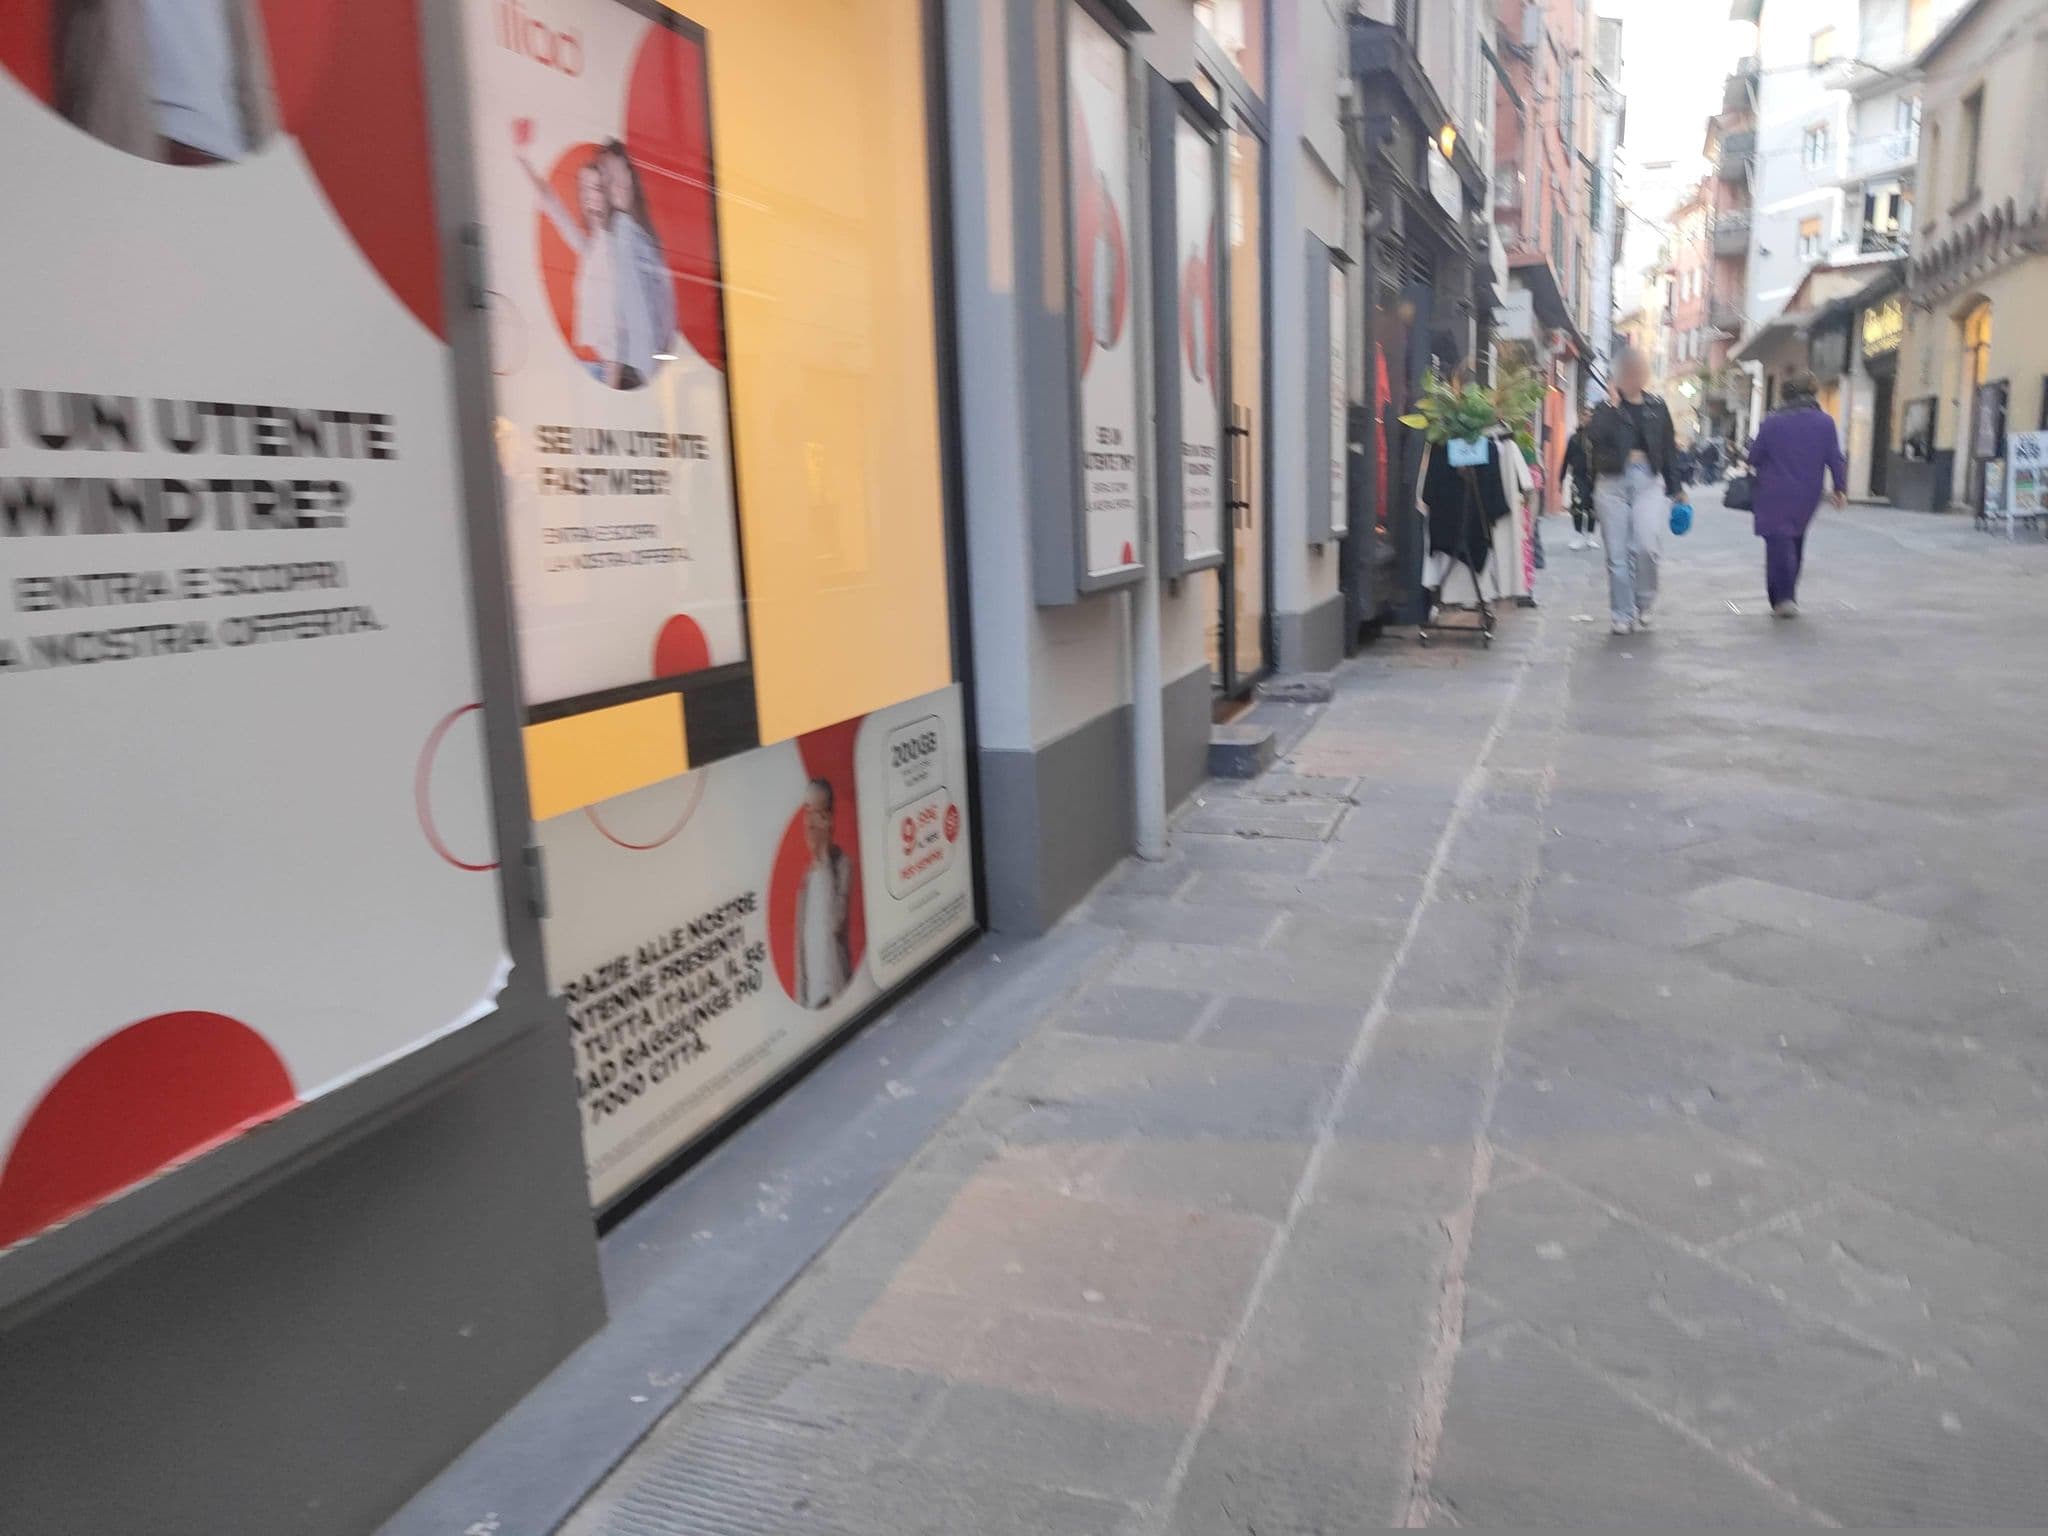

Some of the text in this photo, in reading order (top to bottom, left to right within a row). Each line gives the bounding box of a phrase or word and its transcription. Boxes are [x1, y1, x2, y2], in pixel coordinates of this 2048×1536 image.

[16, 388, 140, 452] UN
[152, 397, 399, 459] UTENTE
[12, 560, 348, 612] ENTRA E SCOPRI
[27, 620, 215, 673] NOSTRA
[635, 926, 685, 973] ALLE
[686, 891, 758, 941] NOSTRE
[656, 925, 747, 989] PRESENTI
[582, 1007, 655, 1062] TUTTA
[590, 1071, 647, 1126] 7000
